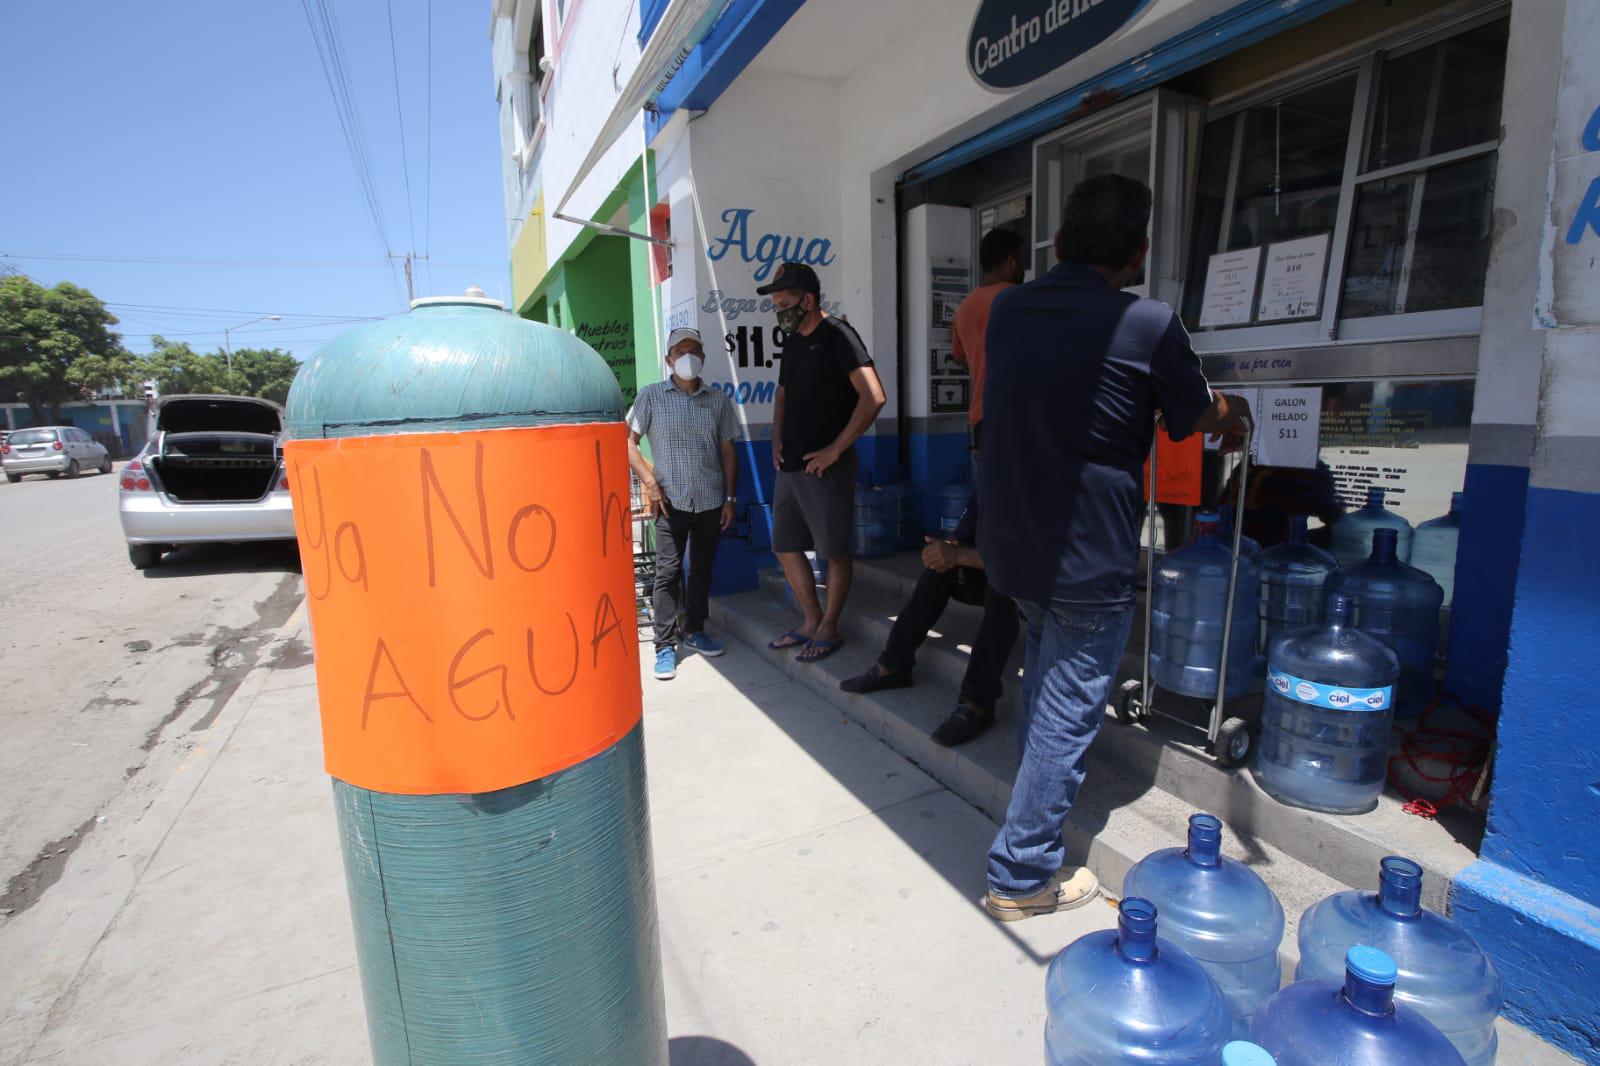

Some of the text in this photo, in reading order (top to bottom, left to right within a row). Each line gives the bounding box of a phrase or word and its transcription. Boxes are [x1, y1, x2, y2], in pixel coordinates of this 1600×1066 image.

[974, 14, 1041, 76] Centro
[706, 208, 836, 282] Agua
[702, 289, 757, 321] Baja
[576, 320, 630, 337] Muebles
[724, 325, 784, 369] $11.9
[1274, 398, 1306, 407] GALON
[1272, 413, 1308, 422] HELADO
[1278, 428, 1298, 439] $11
[294, 458, 368, 601] Ya
[420, 440, 557, 588] No
[362, 592, 629, 731] AGUA
[1275, 677, 1289, 689] ciel
[1329, 693, 1350, 703] ciel
[1366, 694, 1383, 705] ciel
